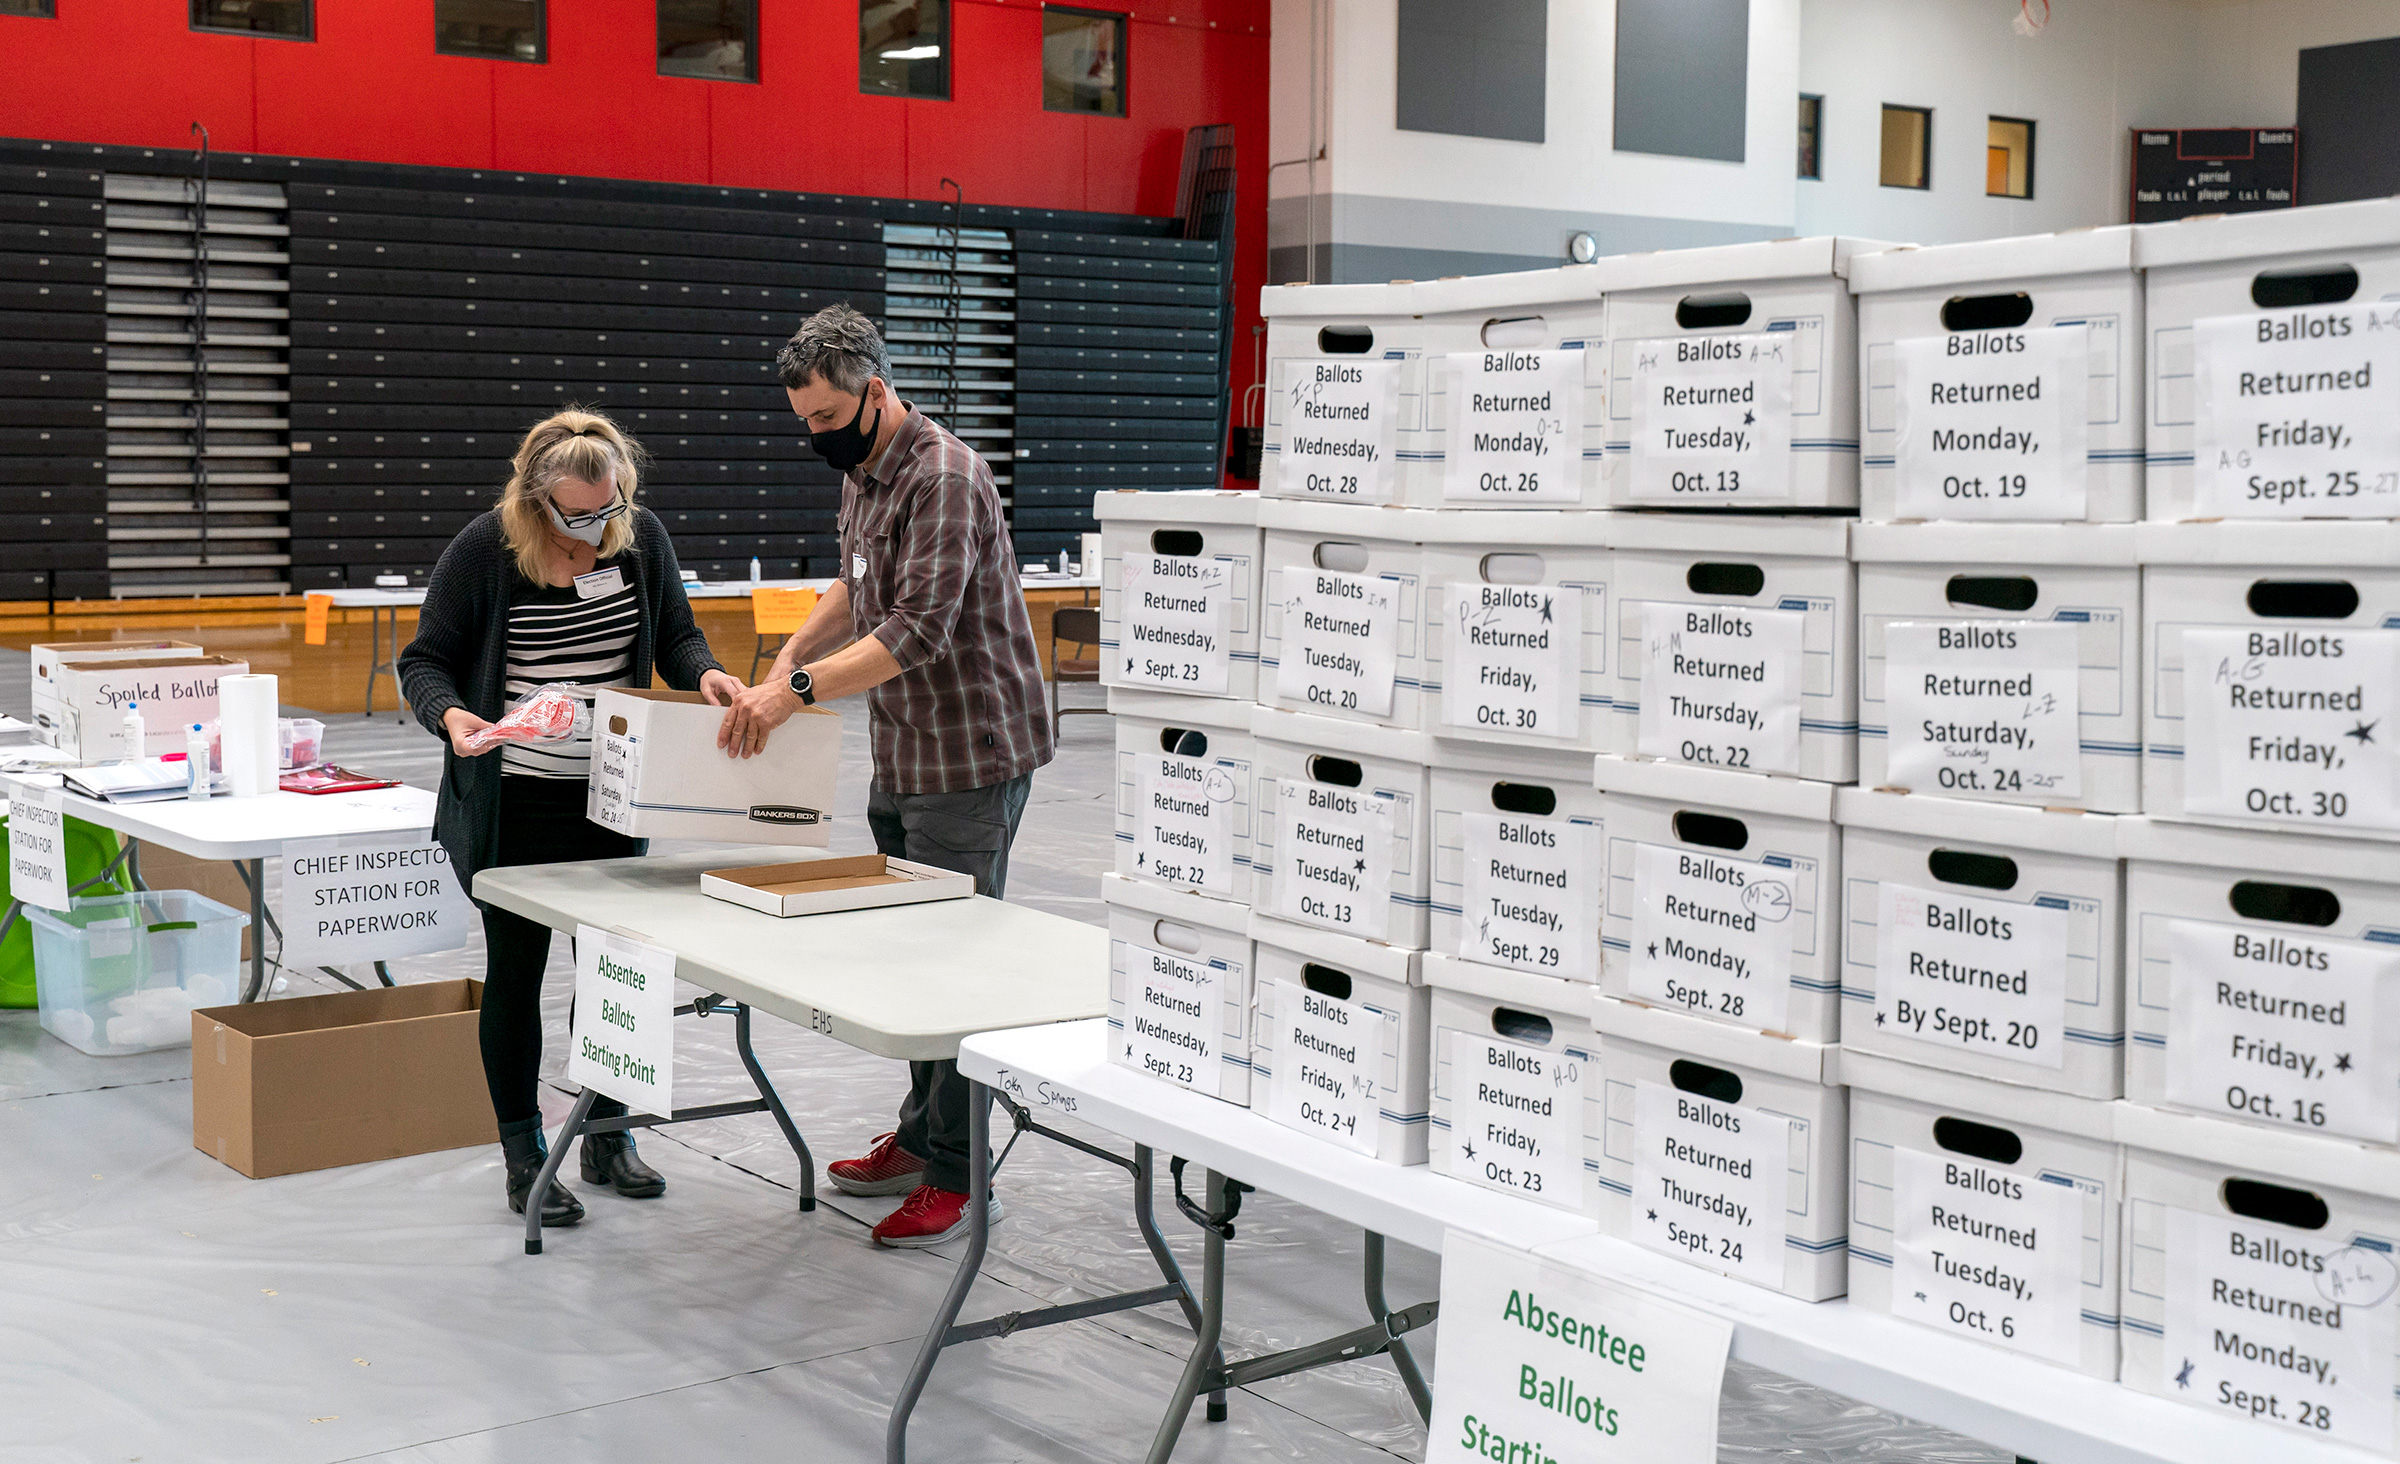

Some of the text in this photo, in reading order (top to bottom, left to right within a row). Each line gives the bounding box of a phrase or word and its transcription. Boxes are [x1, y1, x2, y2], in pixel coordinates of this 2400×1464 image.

[2258, 314, 2351, 342] Ballots
[1678, 340, 1741, 362] Ballots
[1948, 333, 2024, 356] Ballots
[1316, 365, 1362, 383] Ballots
[1484, 353, 1540, 372] Ballots
[1664, 381, 1753, 405] Returned
[1932, 376, 2040, 404] Returned
[2240, 362, 2370, 396] Returned
[1305, 401, 1369, 420] Returned
[1474, 391, 1550, 412] Returned
[1475, 432, 1547, 456] Monday,
[1665, 427, 1750, 452] Tuesday,
[1933, 427, 2038, 454] Monday,
[2258, 420, 2350, 449] Friday,
[1294, 437, 1378, 462] Wednesday,
[1307, 474, 1357, 494] Oct. 28
[1480, 473, 1538, 491] Oct. 26
[1672, 471, 1739, 492] Oct. 13
[1944, 475, 2026, 498] Oct. 19
[2248, 472, 2359, 504] Sept. 25
[1154, 559, 1198, 578] Ballots
[1317, 577, 1363, 599] Ballots
[1482, 588, 1537, 608] Ballots
[1145, 592, 1206, 613] Returned
[1133, 624, 1215, 652] Wednesday,
[1305, 612, 1370, 636] Returned
[1472, 626, 1548, 649] Returned
[1687, 613, 1752, 637] Ballots
[1939, 627, 2016, 649] Ballots
[2248, 632, 2343, 657] Ballots
[1146, 659, 1198, 681] Sept. 23
[1305, 648, 1363, 677] Tuesday,
[1674, 654, 1764, 681] Returned
[1481, 666, 1536, 692] Friday,
[1925, 674, 2031, 696] Returned
[96, 679, 160, 709] Spoiled
[1308, 685, 1356, 709] Oct. 20
[2232, 684, 2361, 711] Returned
[1478, 705, 1536, 728] Oct. 30
[1670, 696, 1763, 730] Thursday,
[607, 739, 622, 755] Ballots
[1924, 720, 2033, 750] Saturday,
[1682, 741, 1749, 768] Oct. 22
[2250, 737, 2344, 769] Friday,
[603, 762, 624, 778] Returned
[1163, 761, 1202, 782] Ballots
[1939, 767, 2022, 791] Oct. 24
[601, 784, 622, 803] Saturday,
[1155, 793, 1209, 817] Returned
[1309, 790, 1356, 814] Ballots
[2247, 788, 2346, 817] Oct. 30
[9, 799, 58, 827] CHIEF INSPECTOR
[753, 810, 815, 820] BANKERS BOX
[15, 830, 52, 854] STATION FOR
[1155, 826, 1207, 854] Tuesday,
[1297, 823, 1363, 852] Returned
[1500, 823, 1555, 847] Ballots
[15, 860, 52, 882] PAPERWORK
[294, 848, 451, 875] CHIEF INSPECTO
[1156, 860, 1203, 884] Sept. 22
[1297, 859, 1361, 891] Tuesday,
[1491, 859, 1566, 888] Returned
[1680, 856, 1744, 887] Ballots
[315, 880, 439, 905] STATION FOR
[319, 910, 437, 937] PAPERWORK
[1301, 897, 1351, 922] Oct. 13
[1491, 898, 1562, 931] Tuesday,
[1666, 895, 1756, 932] Returned
[1928, 904, 2011, 940] Ballots
[1493, 938, 1558, 966] Sept. 29
[1666, 937, 1750, 978] Monday,
[2234, 934, 2328, 971] Ballots
[598, 955, 645, 991] Absentee
[1154, 956, 1193, 982] Ballots
[1911, 952, 2026, 995] Returned
[1146, 987, 1200, 1017] Returned
[1305, 996, 1347, 1024] Ballots
[1666, 980, 1744, 1016] Sept. 28
[2218, 982, 2345, 1025] Returned
[602, 999, 635, 1032] Ballots
[812, 1008, 834, 1034] EHS
[1898, 1000, 2037, 1049] By Sept. 20
[1136, 1016, 1208, 1057] Wednesday,
[1295, 1028, 1355, 1063] Returned
[582, 1040, 655, 1085] Starting Point
[1144, 1053, 1192, 1082] Sept. 23
[1489, 1047, 1541, 1075] Ballots
[2233, 1035, 2323, 1079] Friday,
[1302, 1065, 1345, 1099] Friday,
[1479, 1083, 1551, 1116] Returned
[2227, 1086, 2325, 1126] Oct. 16
[1301, 1102, 1326, 1126] Oct.
[1679, 1099, 1740, 1133] Ballots
[1488, 1124, 1540, 1156] Friday,
[1666, 1137, 1751, 1179] Returned
[1486, 1162, 1541, 1191] Oct. 23
[1946, 1164, 2022, 1199] Ballots
[1662, 1178, 1751, 1227] Thursday,
[1668, 1222, 1742, 1262] Sept. 24
[1932, 1206, 2035, 1250] Returned
[2231, 1232, 2324, 1273] Ballots
[1932, 1251, 2032, 1300] Tuesday,
[2213, 1279, 2341, 1329] Returned
[1504, 1290, 1645, 1372] Absentee
[1950, 1302, 2014, 1338] Oct. 6
[2215, 1329, 2336, 1385] Monday,
[1520, 1364, 1618, 1436] Ballots
[2219, 1381, 2330, 1430] Sept. 28
